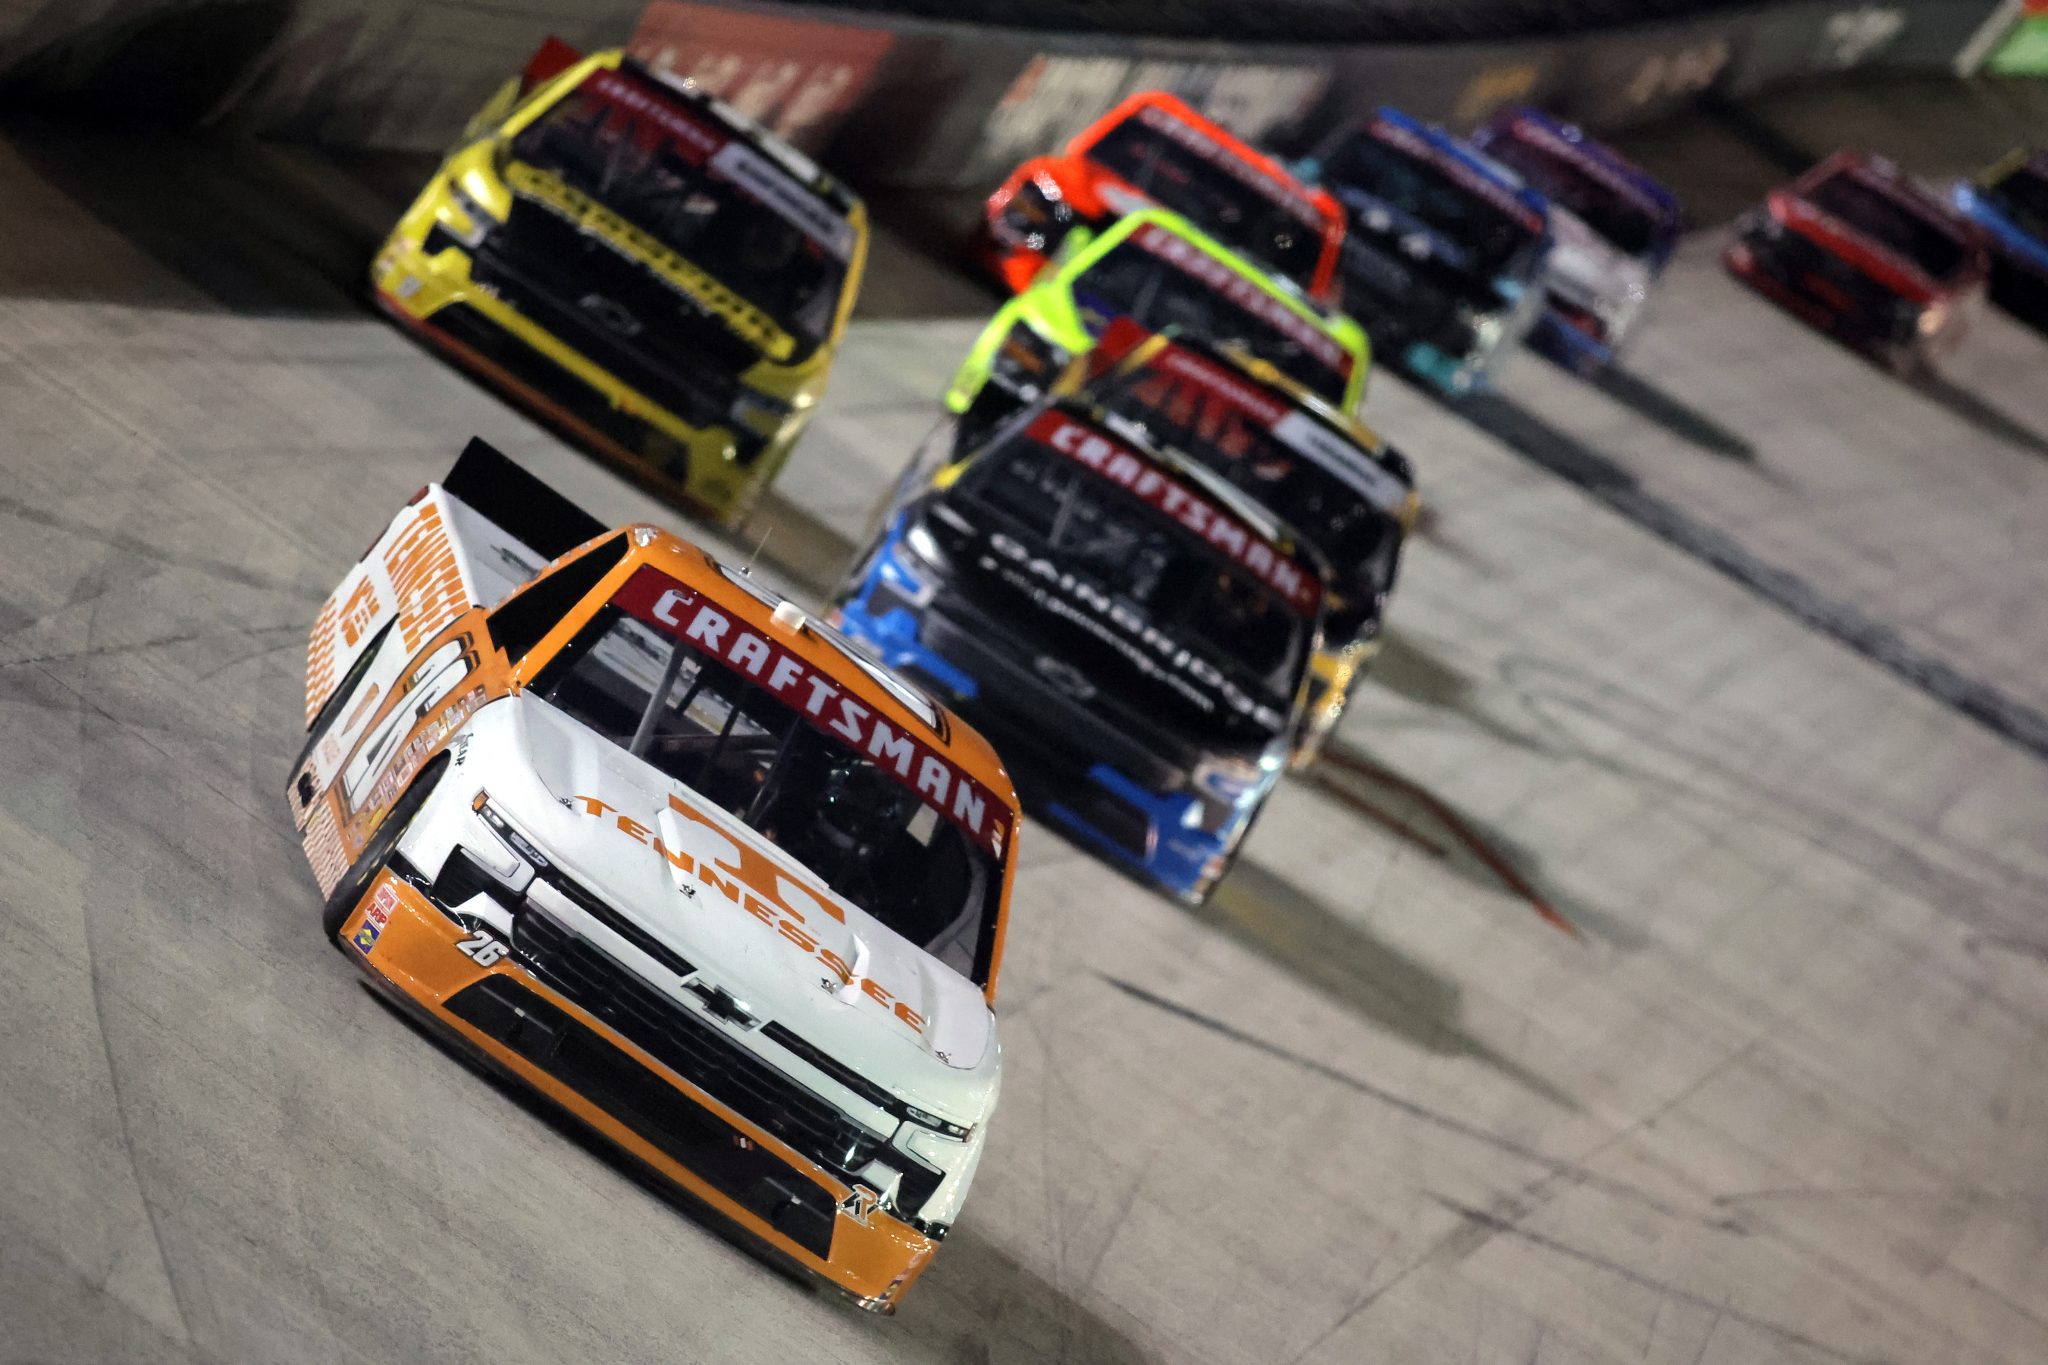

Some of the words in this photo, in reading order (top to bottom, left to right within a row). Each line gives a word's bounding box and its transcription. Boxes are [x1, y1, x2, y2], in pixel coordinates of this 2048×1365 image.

[384, 502, 471, 655] TENNESSEE
[1051, 423, 1301, 596] CRAFTSMAN
[349, 638, 480, 815] 26
[652, 588, 986, 834] CRAFTSMAN
[455, 930, 509, 968] 26
[575, 795, 924, 1035] TENNESSEE
